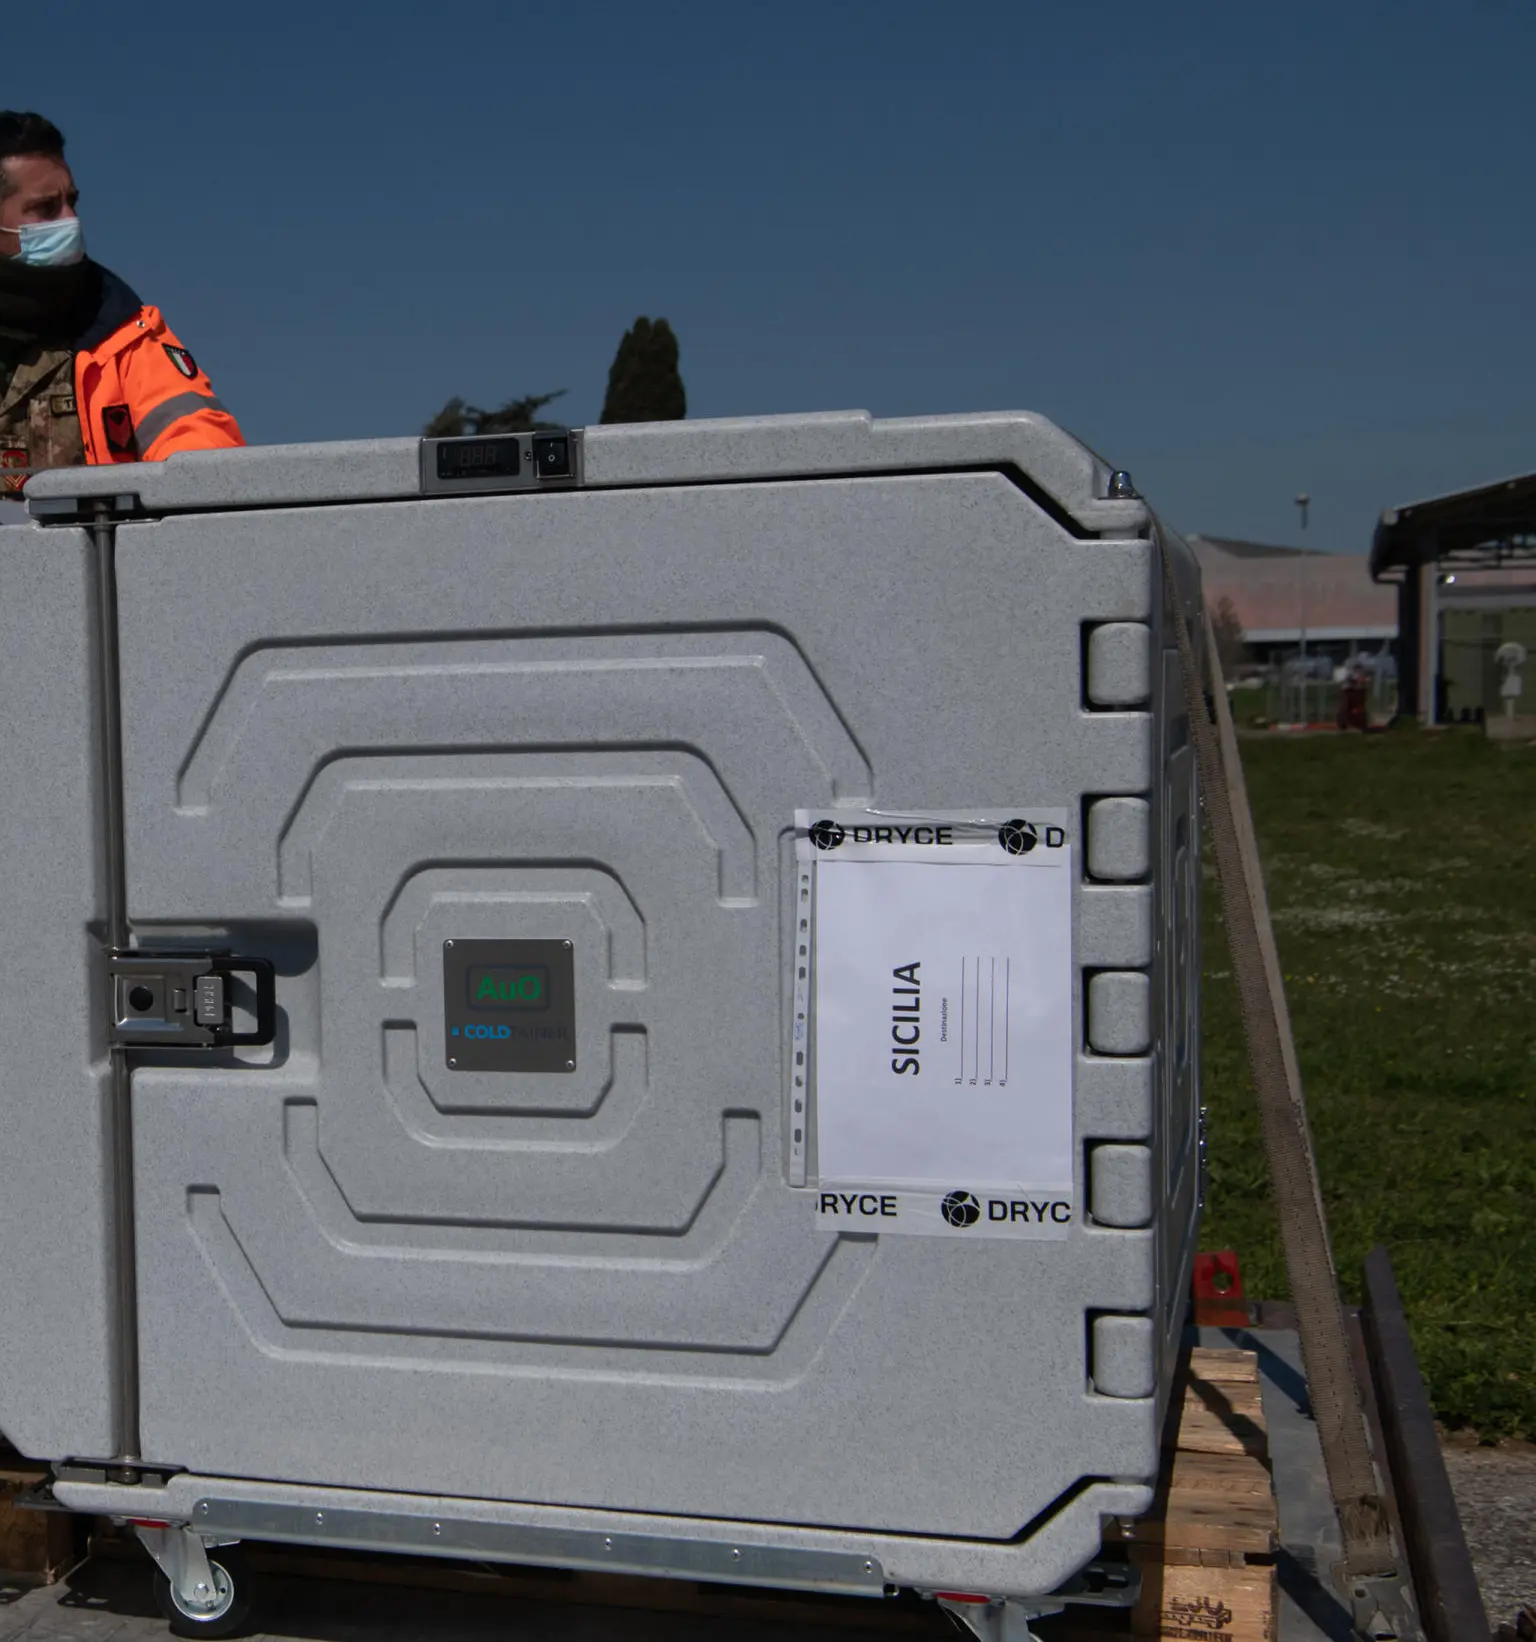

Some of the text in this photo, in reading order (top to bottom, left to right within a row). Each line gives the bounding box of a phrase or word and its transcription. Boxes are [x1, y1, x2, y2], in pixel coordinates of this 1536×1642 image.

[853, 826, 953, 845] DRYCE
[891, 961, 921, 1076] SICILIA
[940, 997, 948, 1042] Destinazione
[816, 1193, 1071, 1224] RYCE DRYC
